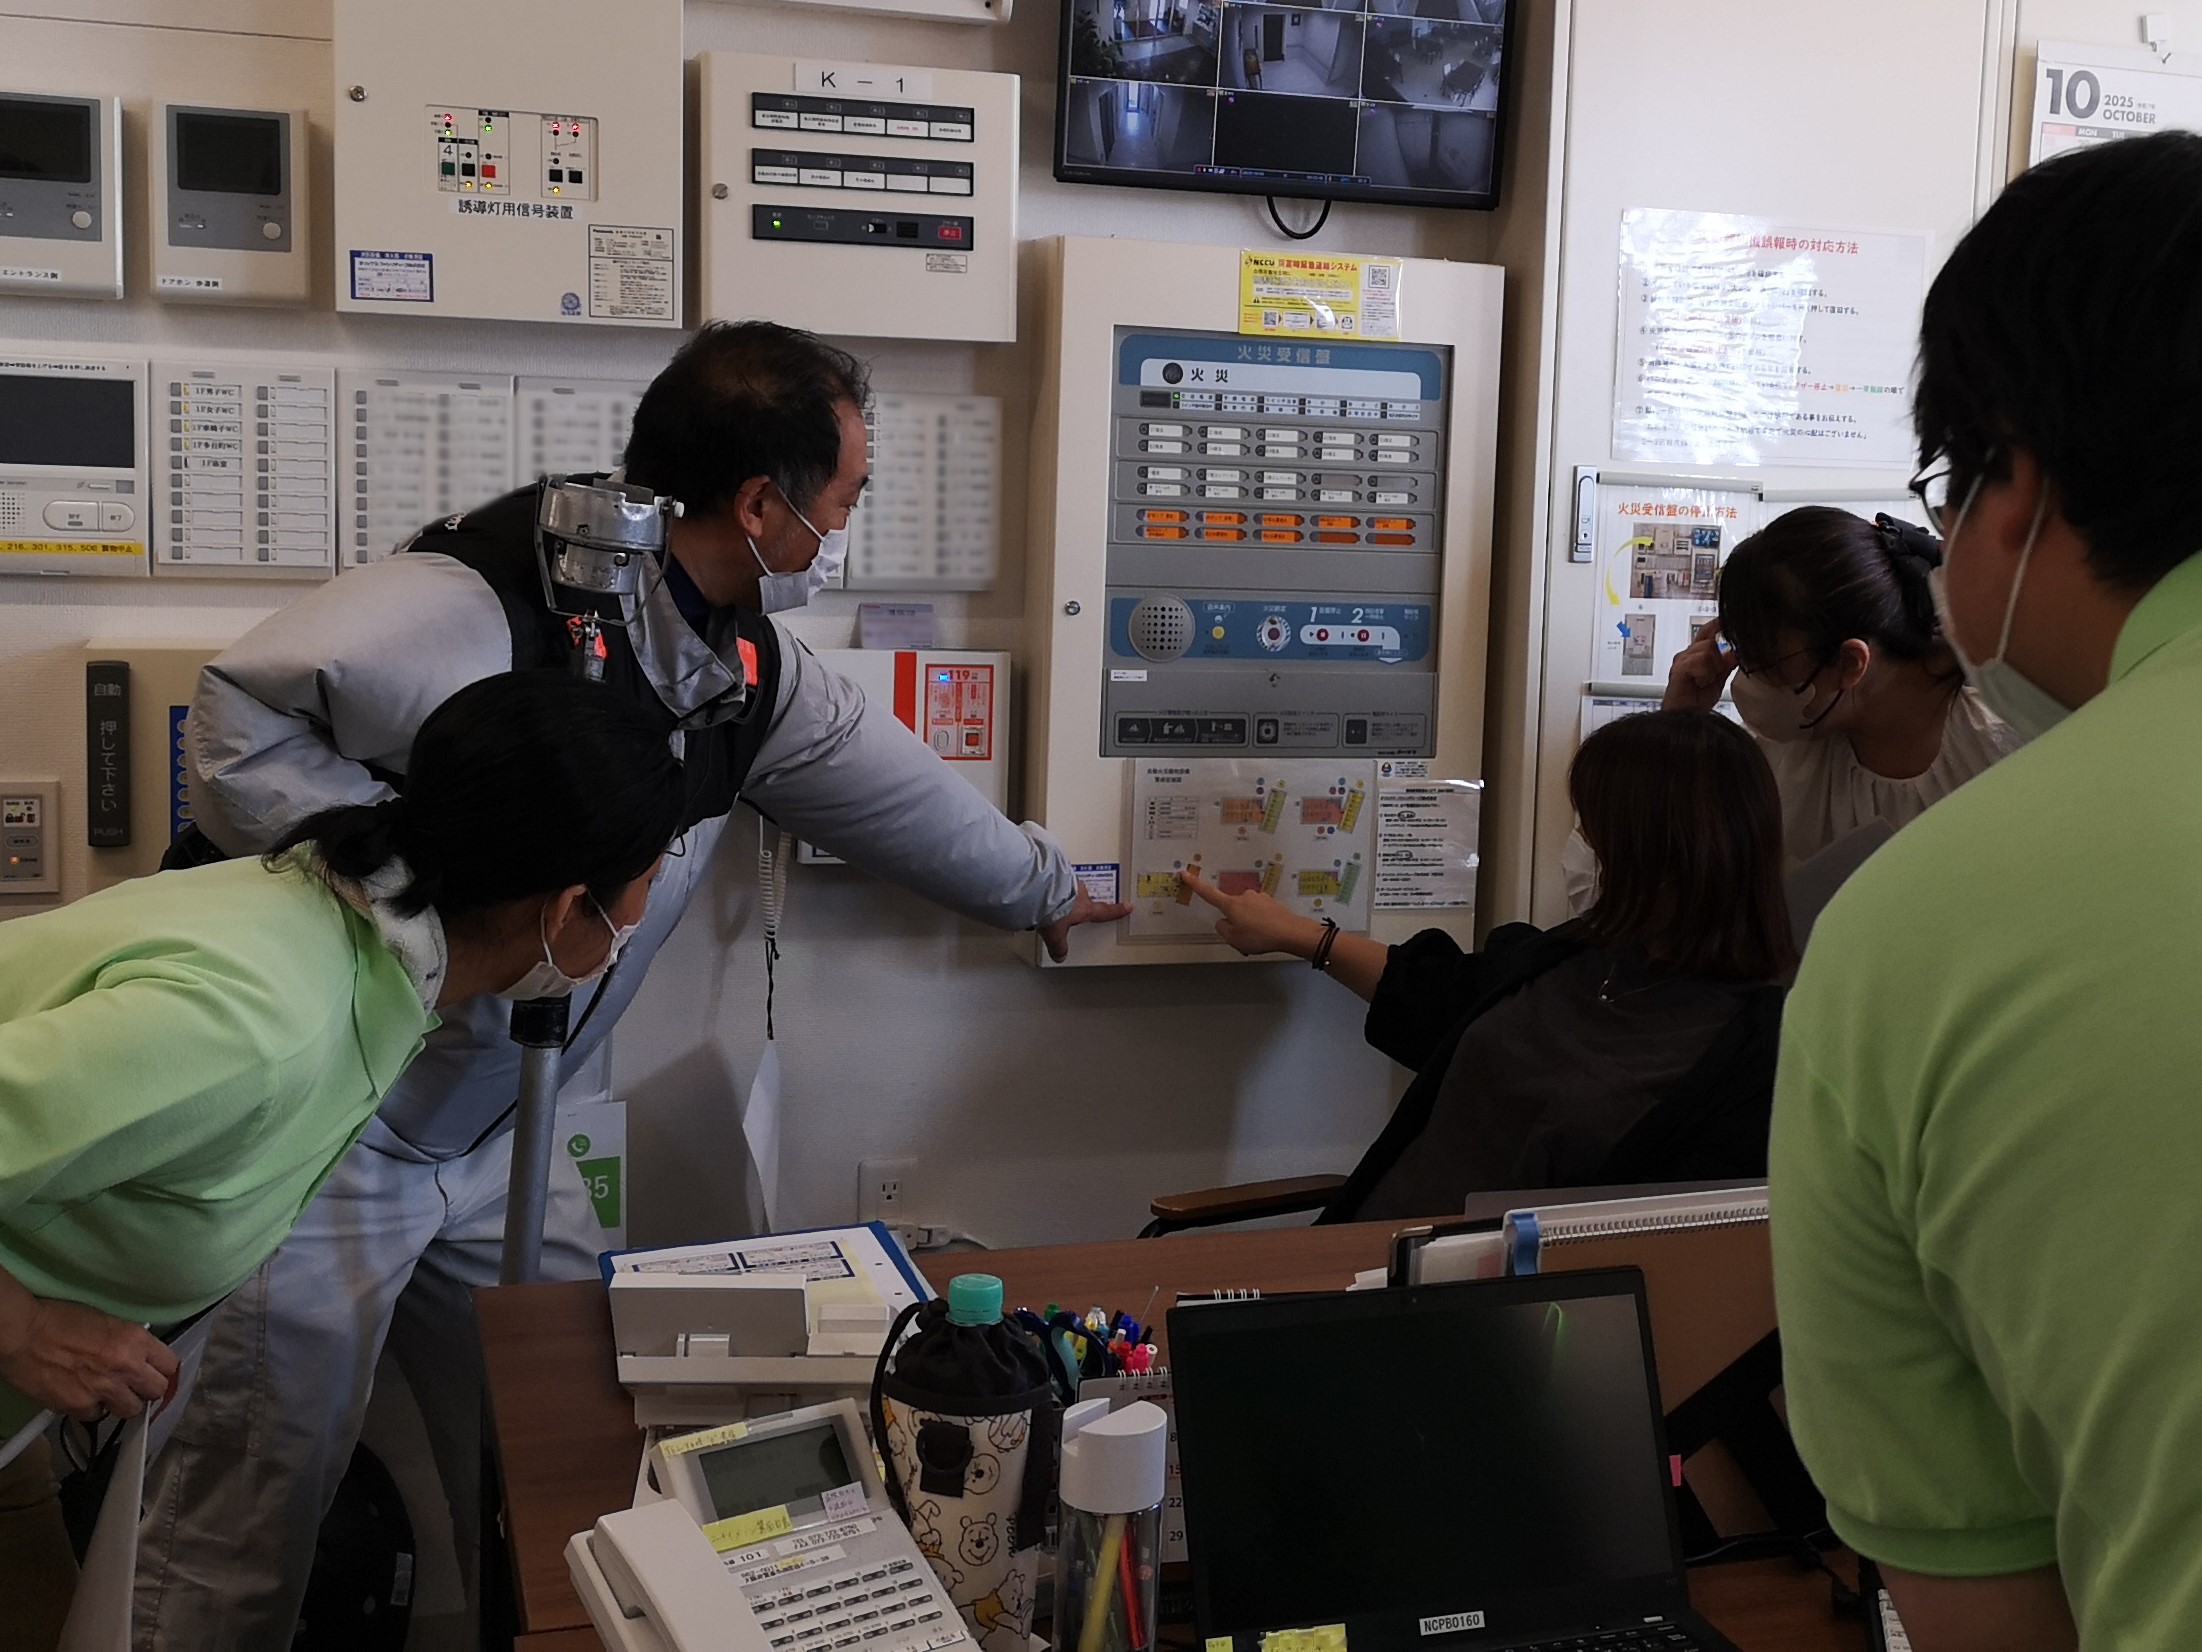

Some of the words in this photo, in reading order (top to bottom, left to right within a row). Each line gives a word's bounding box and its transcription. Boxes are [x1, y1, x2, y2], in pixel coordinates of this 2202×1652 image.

[821, 71, 836, 88] K
[2046, 68, 2101, 119] 10
[2104, 94, 2134, 108] 2025
[2102, 109, 2156, 124] OCTOBER
[2078, 128, 2097, 137] MON
[458, 199, 574, 219] 誘導灯用信号装置
[1253, 259, 1275, 267] NCCU
[1238, 345, 1331, 364] 火災受信盤
[1190, 367, 1229, 384] 火災
[1310, 606, 1318, 623] 1
[1351, 607, 1364, 624] 2
[948, 669, 970, 681] 119
[94, 683, 121, 697] 自動
[99, 720, 118, 812] 押して下さい
[94, 827, 124, 837] PUSH
[1170, 1431, 1177, 1442] 8
[1169, 1464, 1181, 1475] 15
[1169, 1497, 1183, 1508] 22
[1169, 1531, 1184, 1541] 29
[740, 1551, 762, 1562] 101
